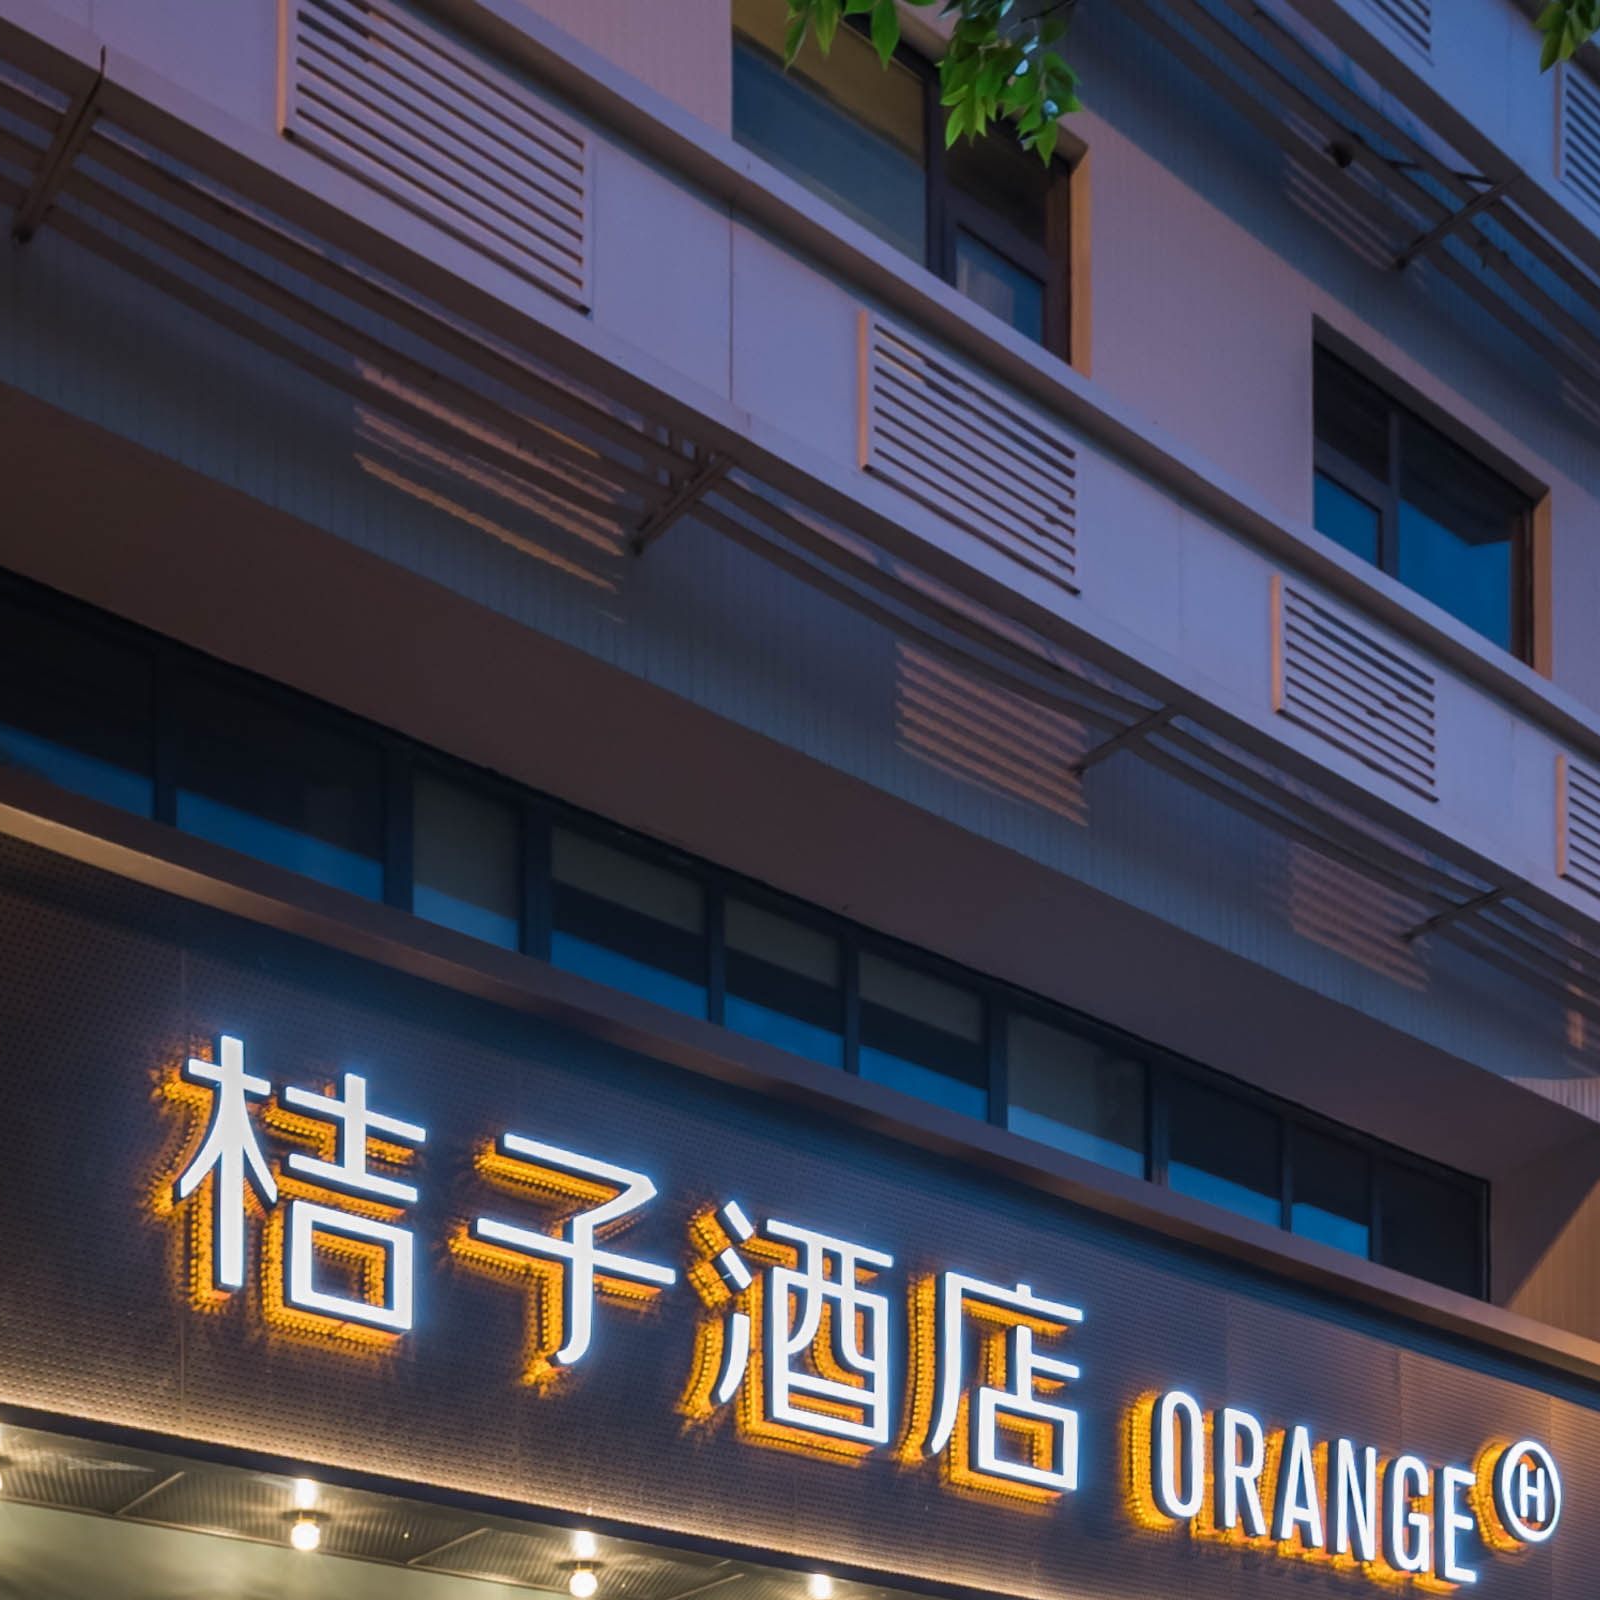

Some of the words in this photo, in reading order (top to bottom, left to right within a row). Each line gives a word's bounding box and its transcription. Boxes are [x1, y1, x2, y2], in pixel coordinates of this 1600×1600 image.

[179, 1034, 1084, 1492] 桔子酒店
[1155, 1390, 1477, 1583] ORANGE
